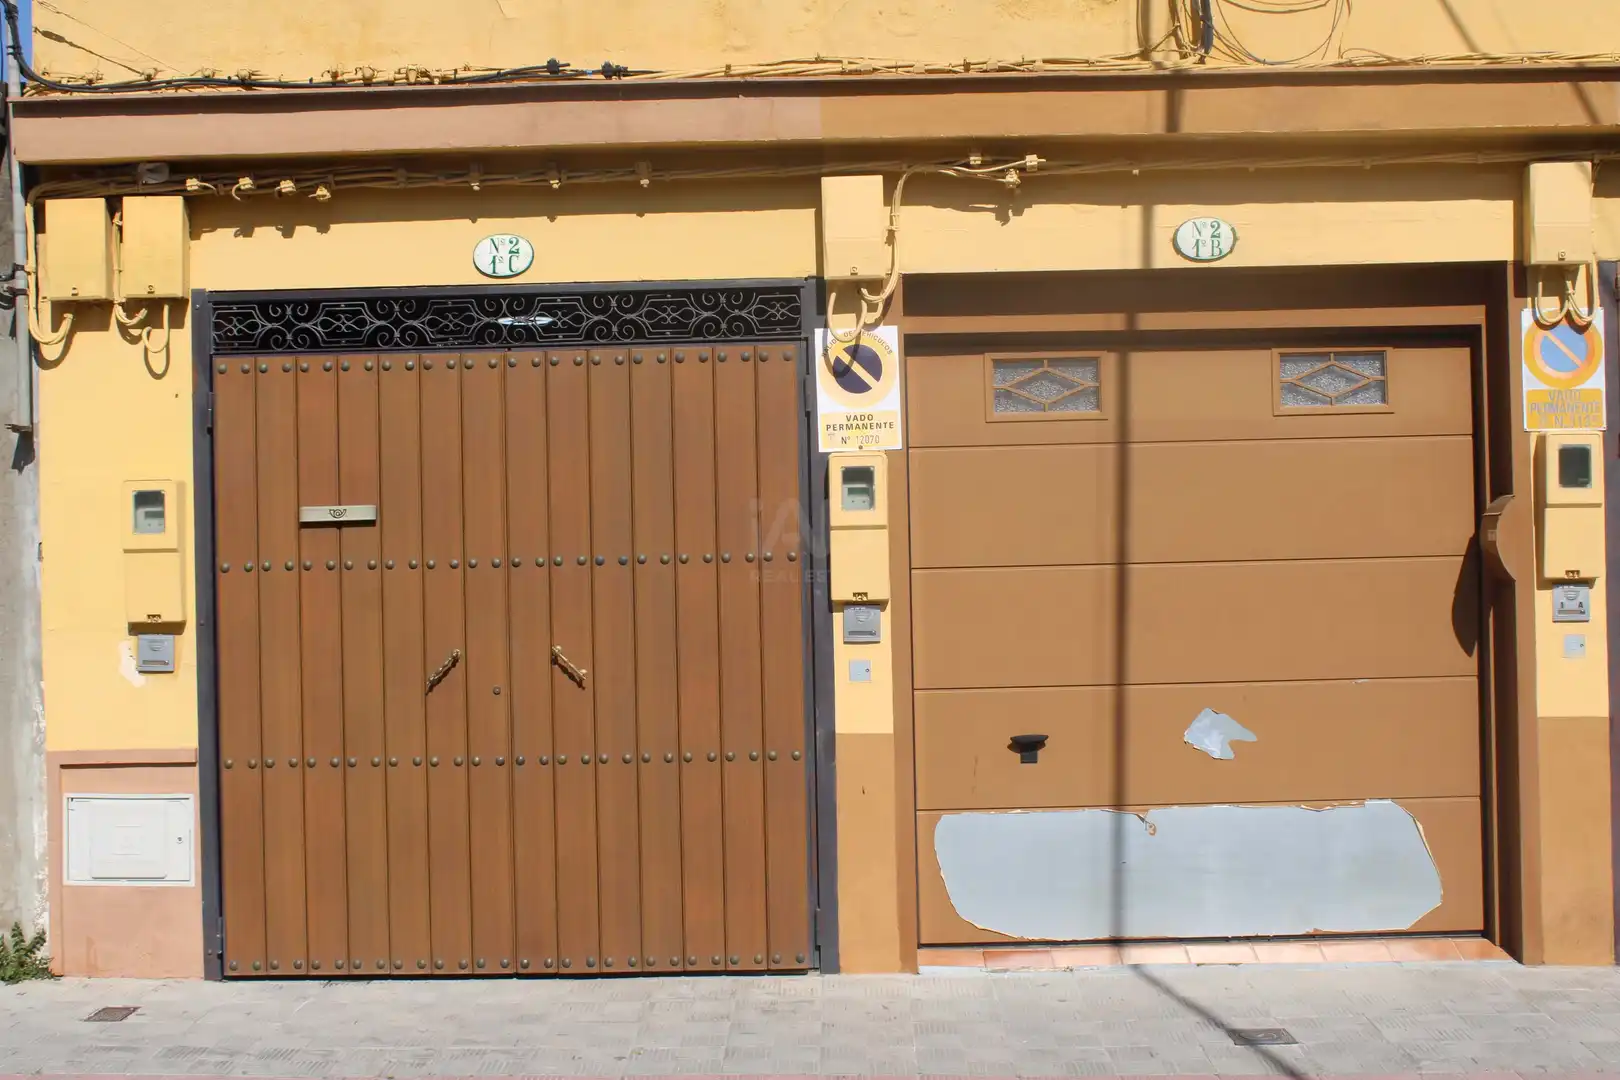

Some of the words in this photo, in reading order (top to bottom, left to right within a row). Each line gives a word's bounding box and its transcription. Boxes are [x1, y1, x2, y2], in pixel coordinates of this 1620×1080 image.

[1210, 220, 1221, 238] 2
[508, 236, 520, 254] 2
[1209, 239, 1222, 257] B
[508, 254, 520, 273] C
[860, 330, 894, 355] EHICULOS
[826, 421, 894, 432] PERMANENTE
[845, 413, 874, 422] VADO
[855, 434, 880, 445] 12070
